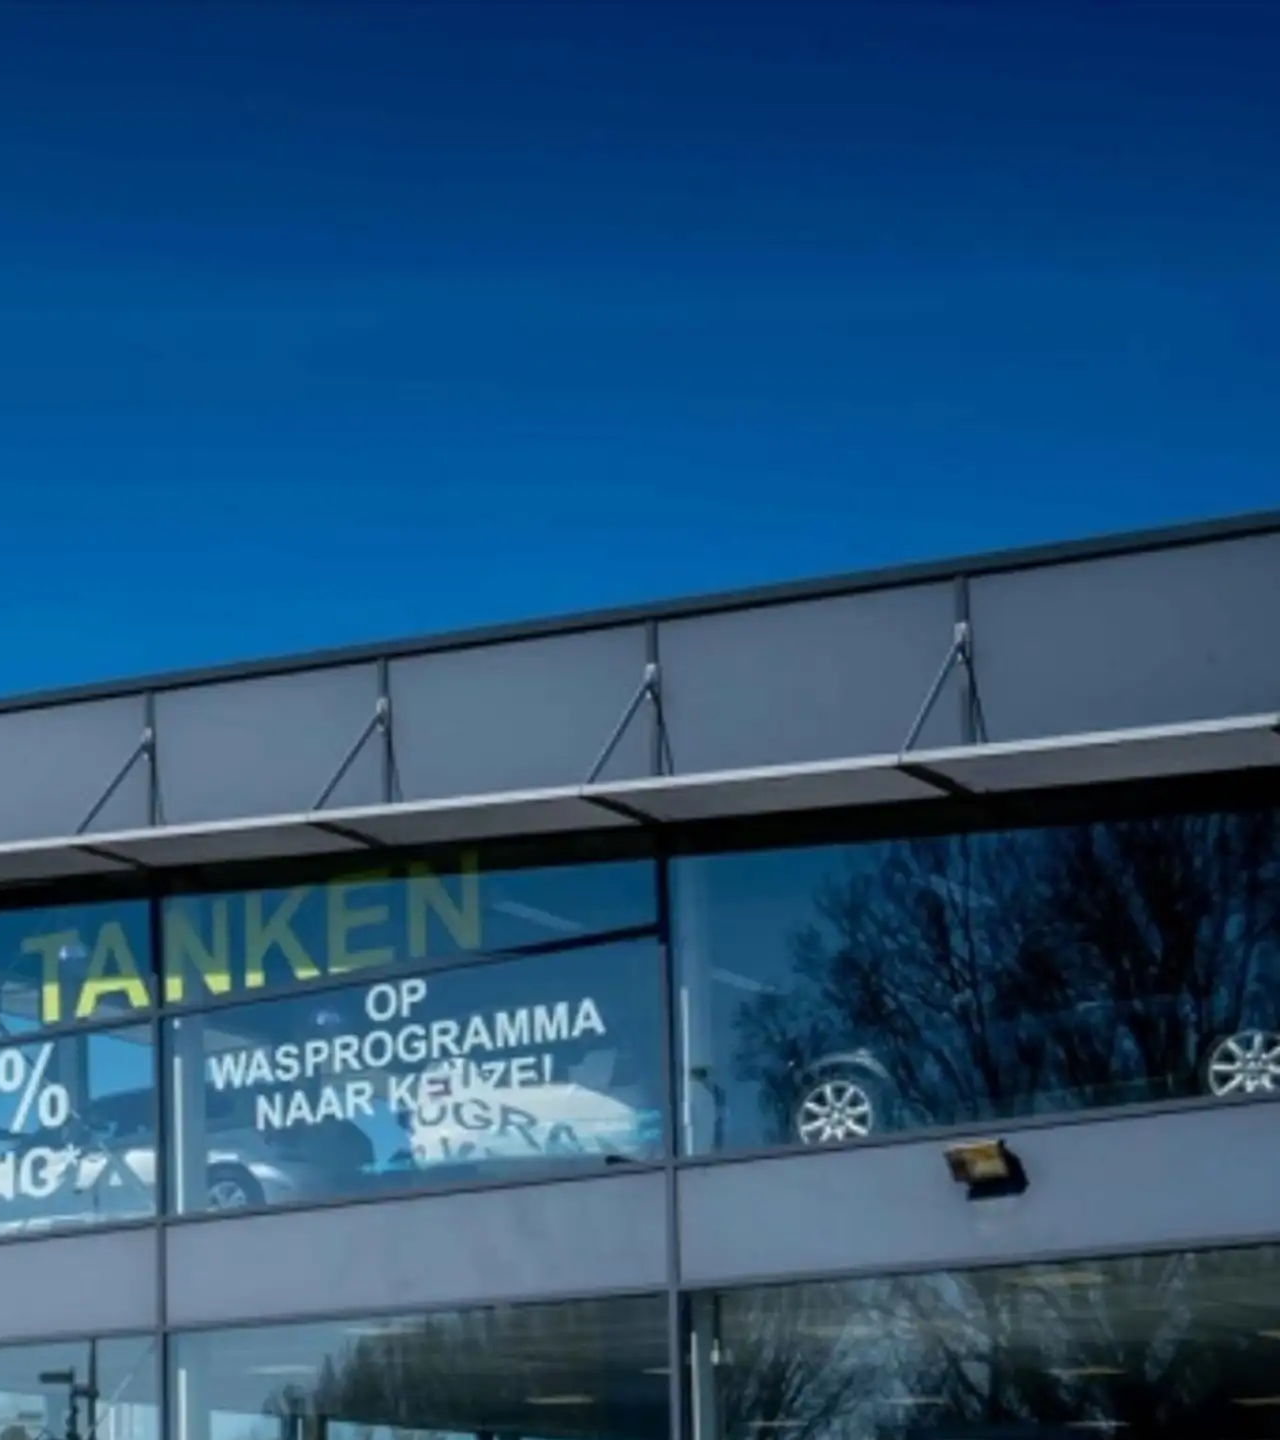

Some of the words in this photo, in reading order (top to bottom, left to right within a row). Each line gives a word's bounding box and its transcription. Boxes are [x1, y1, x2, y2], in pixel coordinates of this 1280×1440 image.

[20, 850, 484, 1023] TANKEN
[363, 978, 428, 1023] OP
[208, 997, 606, 1091] WASPROGRAMMA
[255, 1080, 374, 1131] NAAR
